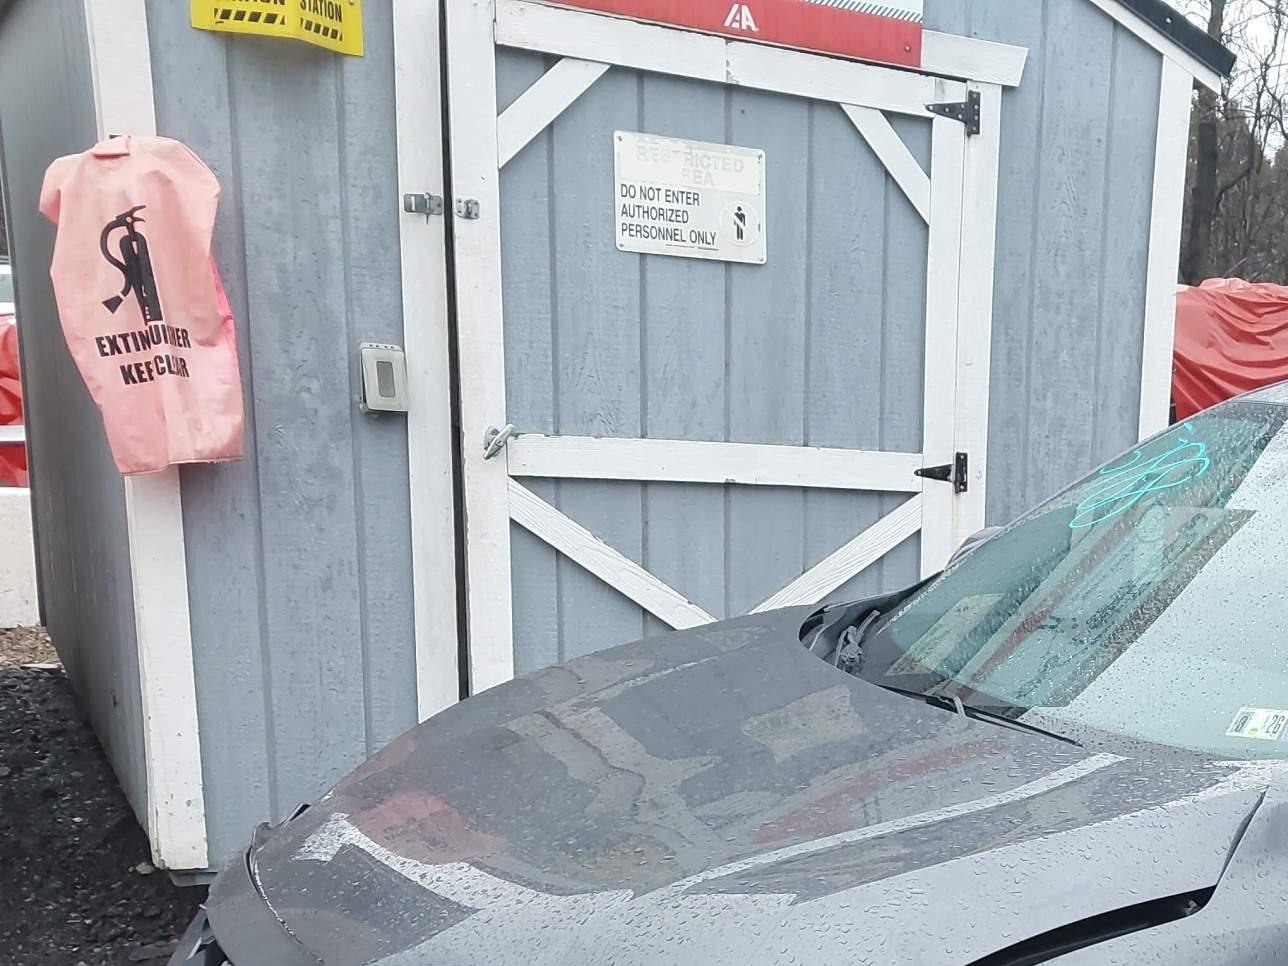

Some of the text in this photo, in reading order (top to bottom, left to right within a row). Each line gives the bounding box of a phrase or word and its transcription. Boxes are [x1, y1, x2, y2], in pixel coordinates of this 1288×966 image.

[300, 0, 342, 22] STATION
[620, 183, 700, 206] DO NOT ENTER
[620, 203, 690, 224] AUTHORIZED
[621, 223, 717, 245] PERSONNEL ONLY
[1265, 714, 1285, 734] 26
